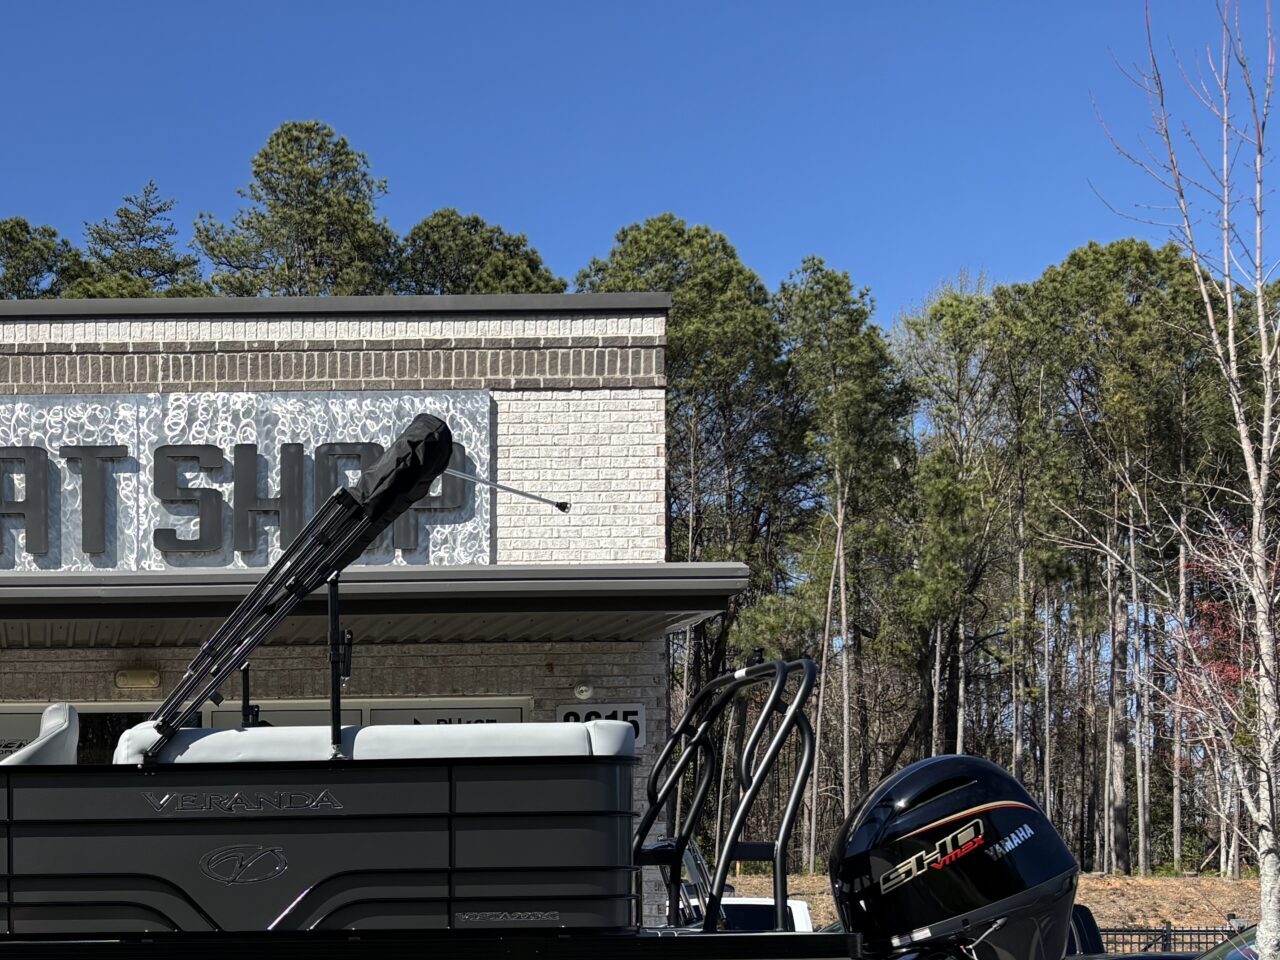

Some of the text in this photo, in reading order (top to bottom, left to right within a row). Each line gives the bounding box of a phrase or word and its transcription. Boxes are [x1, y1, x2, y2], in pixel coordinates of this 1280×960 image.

[141, 788, 345, 813] VERANDA
[880, 818, 985, 895] SHO
[984, 823, 1035, 862] YAMAHA
